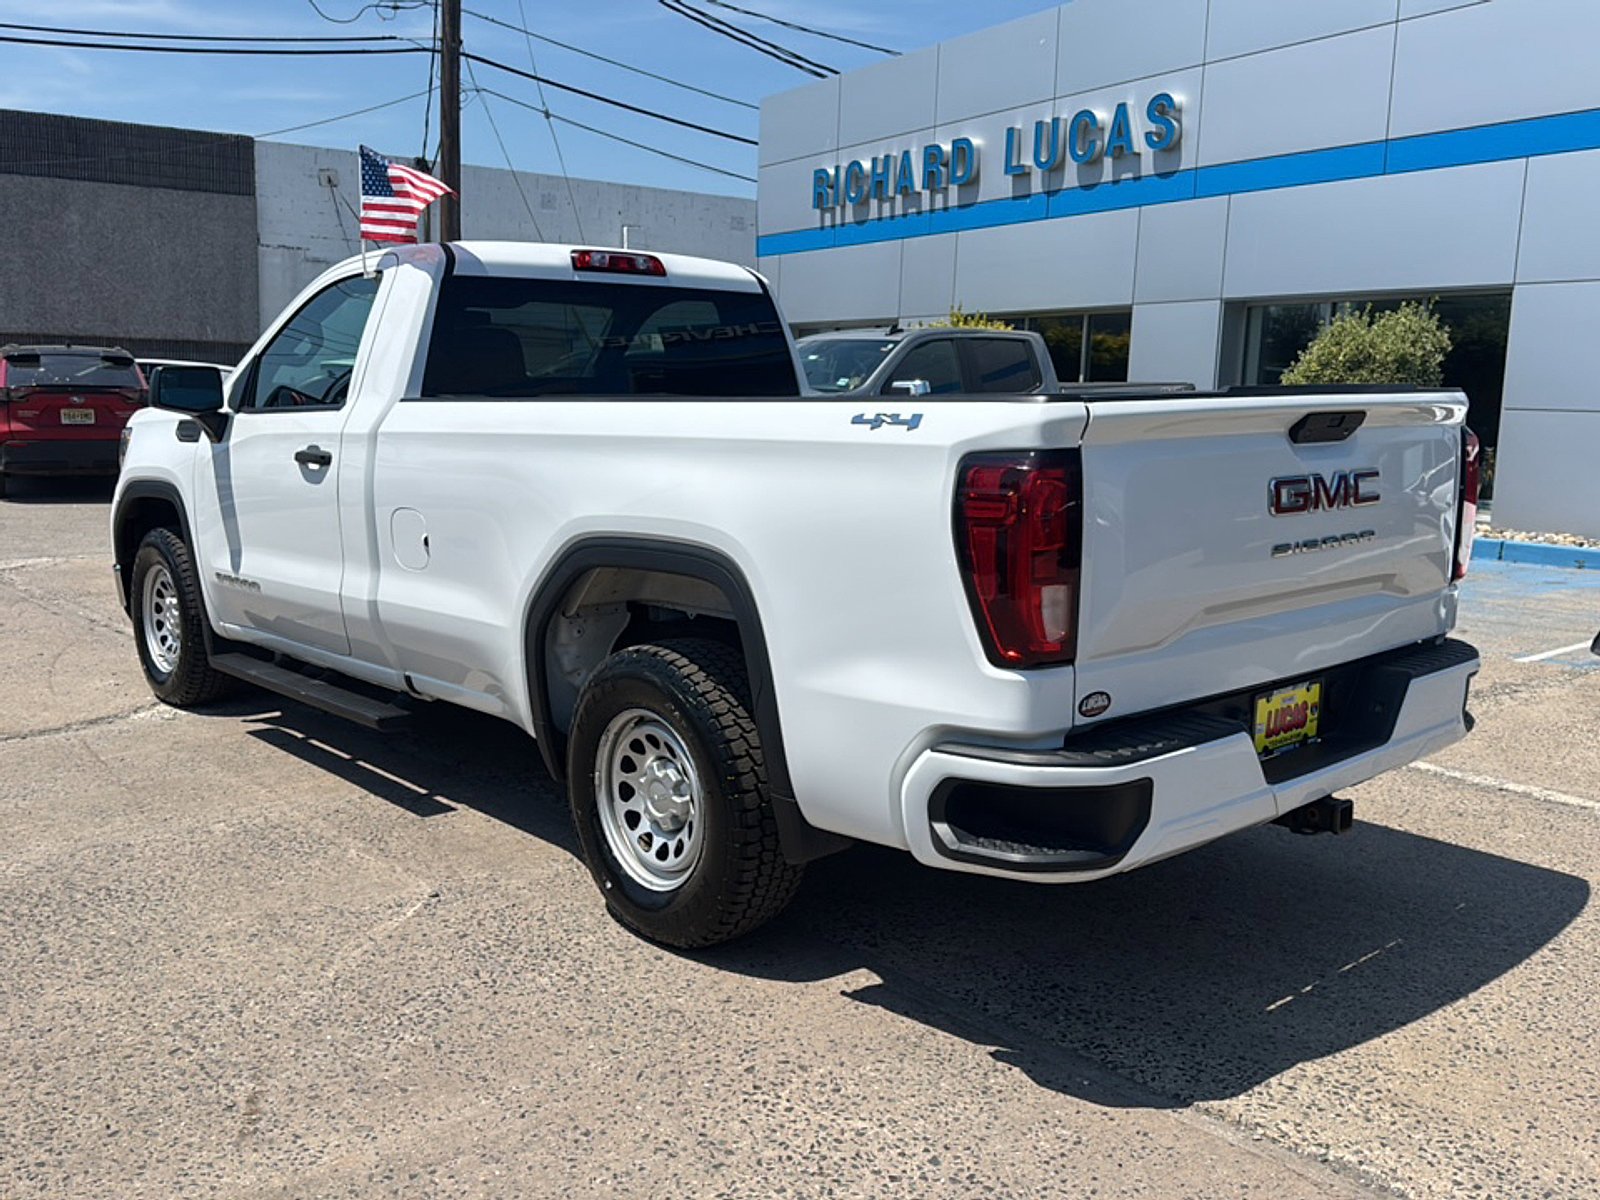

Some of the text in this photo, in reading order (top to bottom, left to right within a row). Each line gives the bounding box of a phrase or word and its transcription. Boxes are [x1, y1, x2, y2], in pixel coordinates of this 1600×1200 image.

[812, 92, 1178, 209] RICHARD LUCAS
[1267, 470, 1382, 517] GMC
